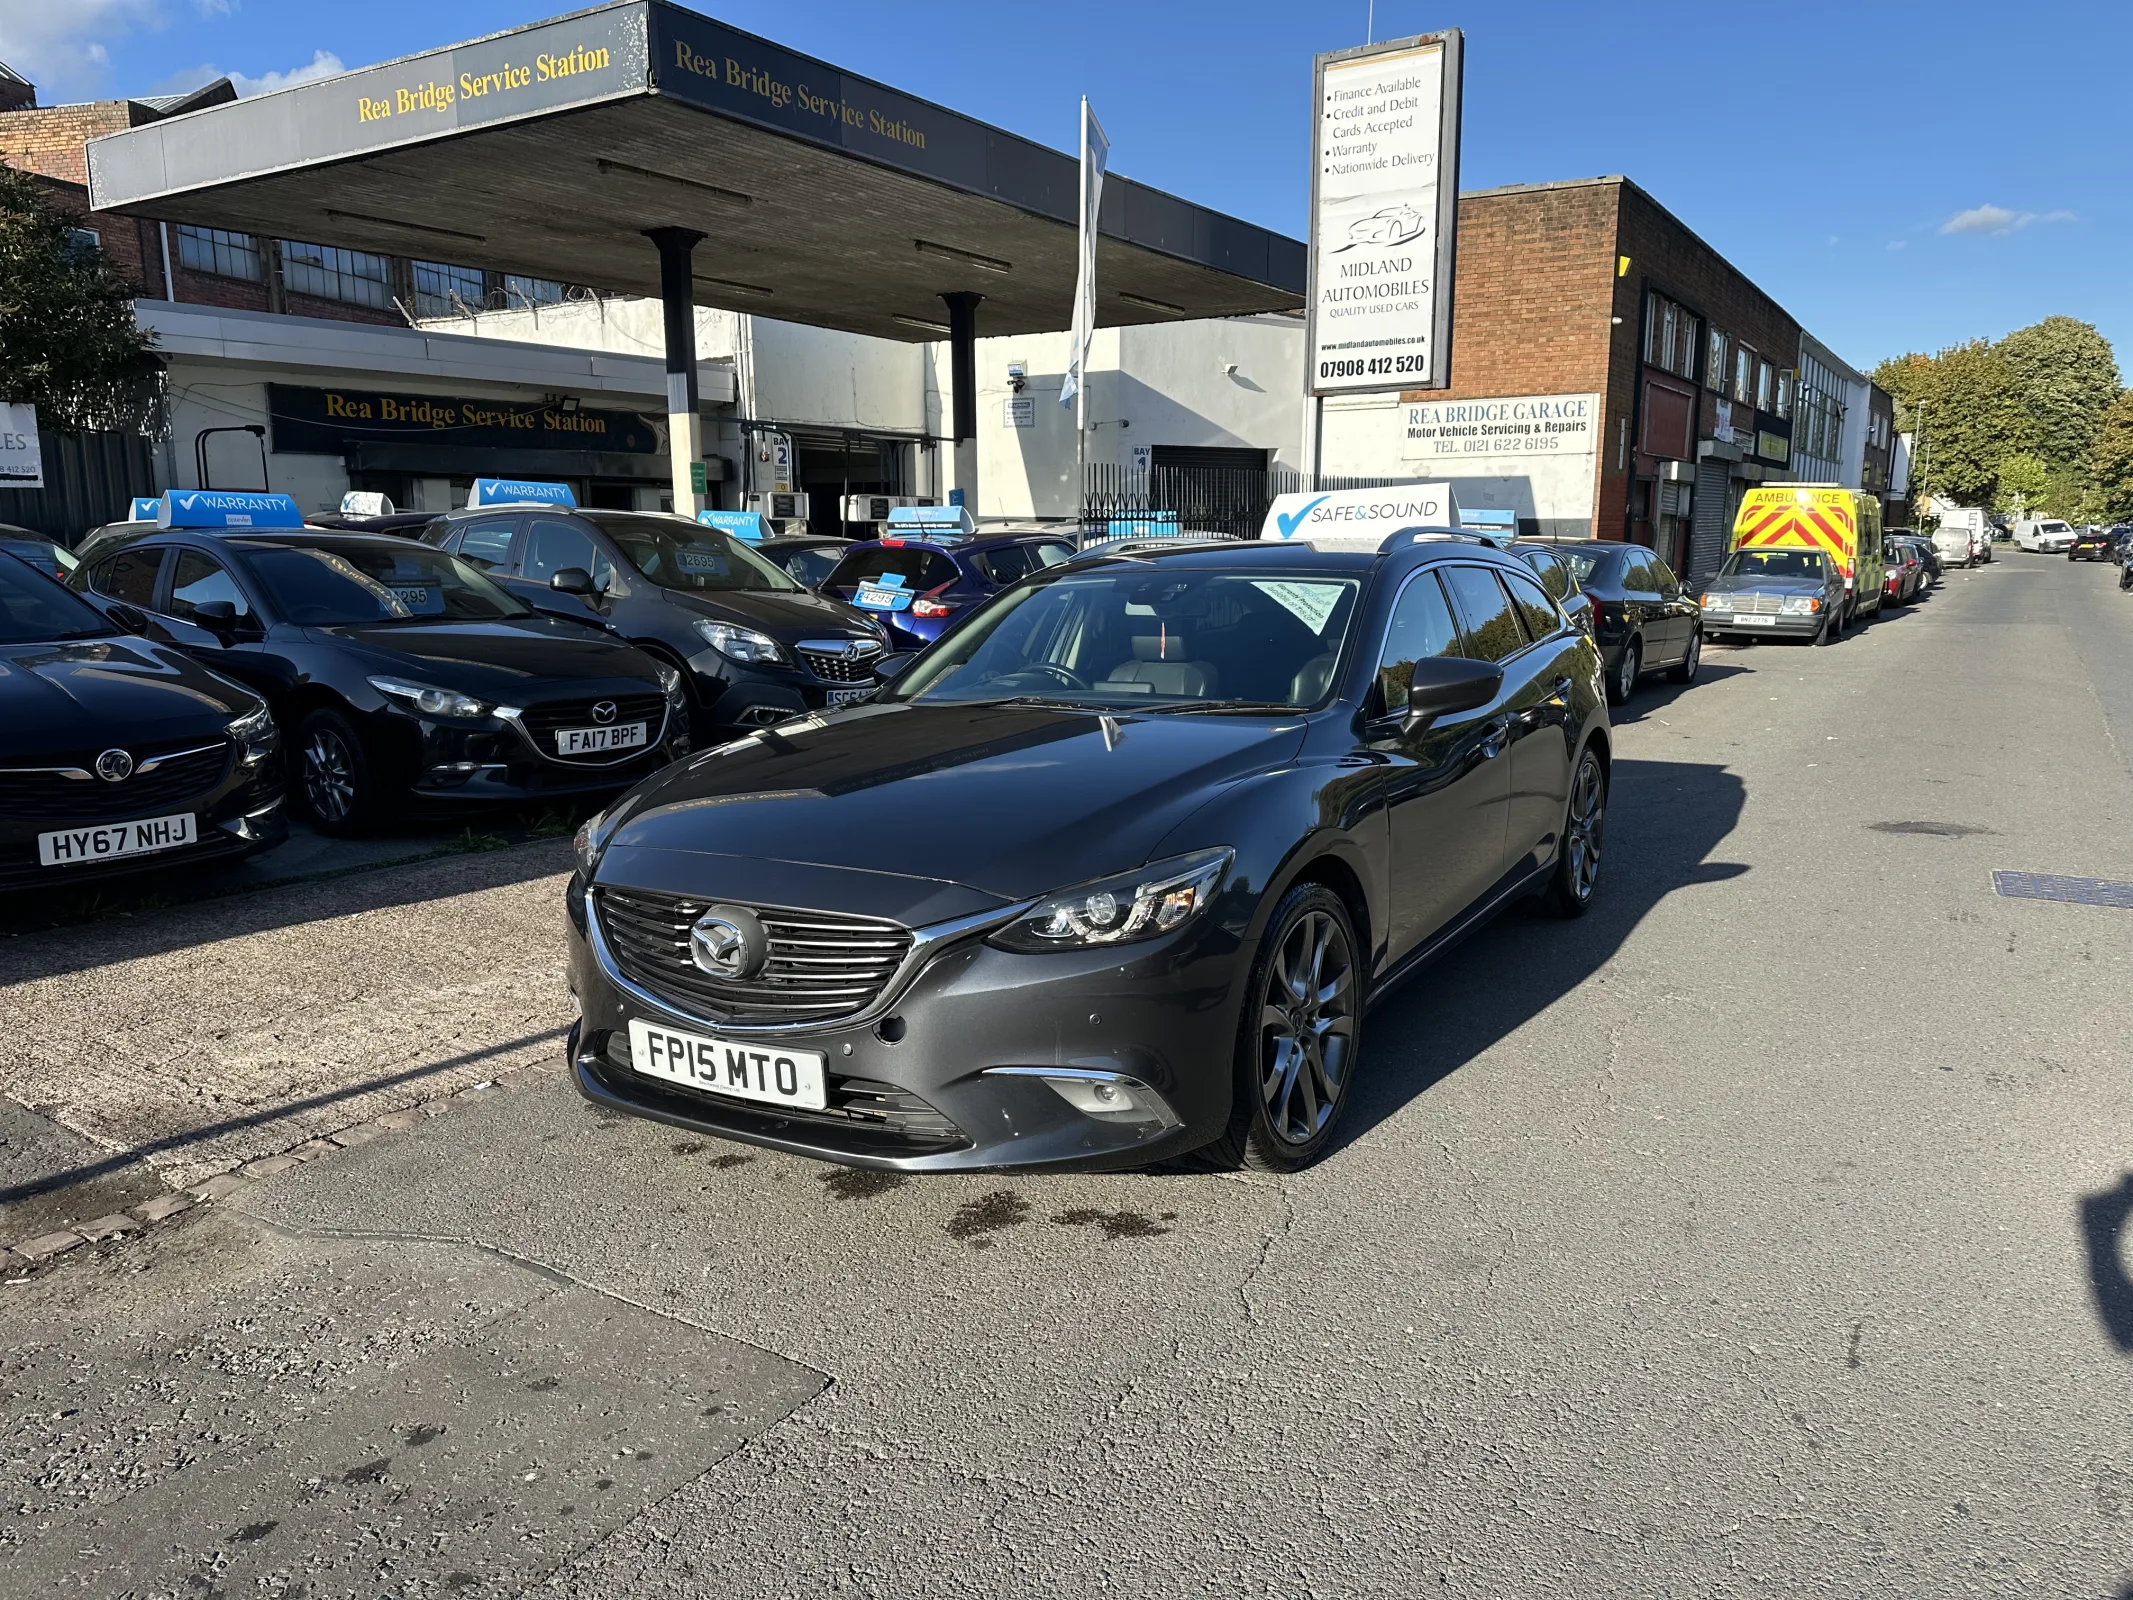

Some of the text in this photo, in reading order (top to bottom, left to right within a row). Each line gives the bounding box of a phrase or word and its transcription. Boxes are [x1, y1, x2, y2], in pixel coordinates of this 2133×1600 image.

[358, 45, 610, 123] Rea Bridge Service Station
[674, 39, 925, 149] Rea Bridge Service Station
[1334, 77, 1421, 102] Finance Available
[1333, 97, 1418, 120] Credit and Debit
[1333, 115, 1412, 138] Cards Accepted
[1332, 142, 1377, 157] Warranty
[1332, 153, 1435, 175] Nationwide Delivery
[1340, 257, 1412, 278] MIDLAND
[1322, 279, 1429, 303] AUTOMOBILES
[1329, 301, 1419, 318] QUALITY USED CARS
[1321, 336, 1425, 351] www.midlandautomobiles.co.uk
[1320, 354, 1424, 378] 07908 412 520
[325, 394, 606, 433] Rea Bridge Service Station
[1409, 400, 1587, 425] REA BRIDGE GARAGE
[1407, 420, 1587, 439] Motor Vehicle Servicing & Repairs
[778, 447, 787, 464] 2
[1134, 448, 1150, 456] BAY
[1434, 437, 1558, 453] TEL. 0121 622 6195
[501, 484, 566, 498] WARRANTY
[200, 496, 287, 511] WARRANTY
[712, 516, 756, 526] WARRANTY
[569, 726, 639, 751] FA17 BPF
[52, 818, 186, 860] HY67 NHJ
[647, 1030, 798, 1096] FP15 MTO
